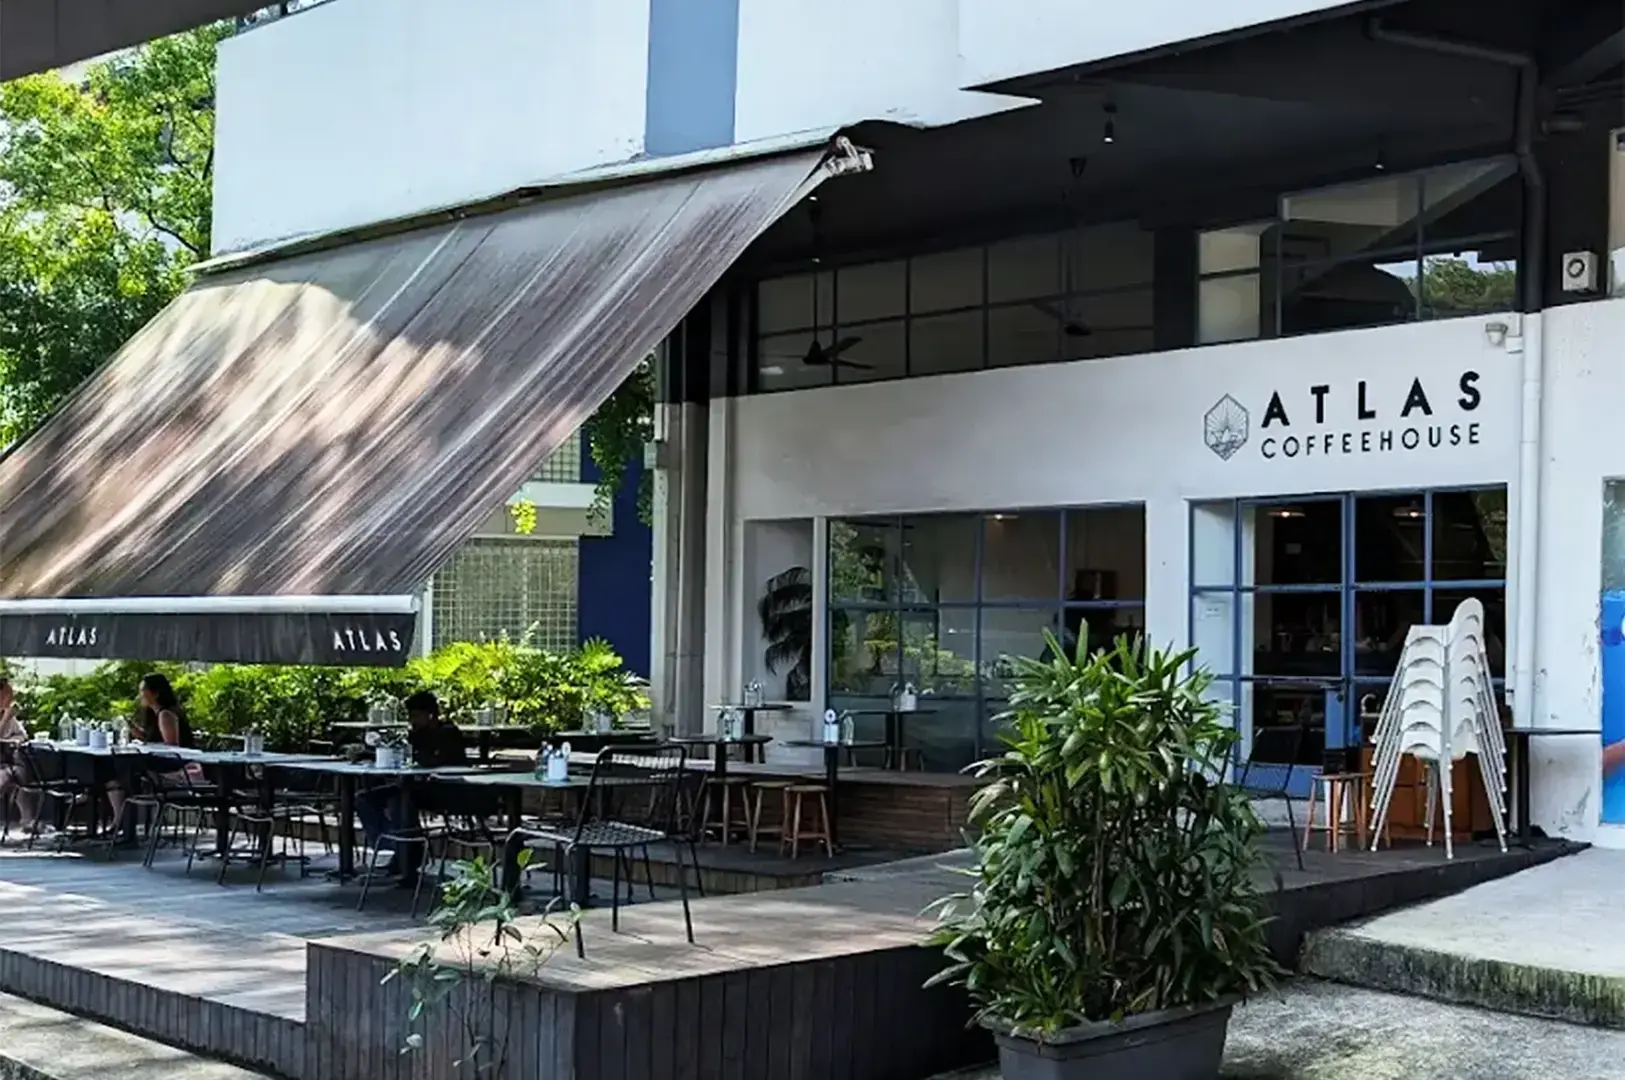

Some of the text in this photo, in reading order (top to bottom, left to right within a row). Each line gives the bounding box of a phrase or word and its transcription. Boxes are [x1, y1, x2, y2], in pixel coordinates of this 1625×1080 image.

[1261, 371, 1481, 428] ATLAS
[1261, 423, 1481, 459] COFFEEHOUSE
[46, 627, 96, 645] ATLAS
[334, 629, 401, 651] ATLAS
